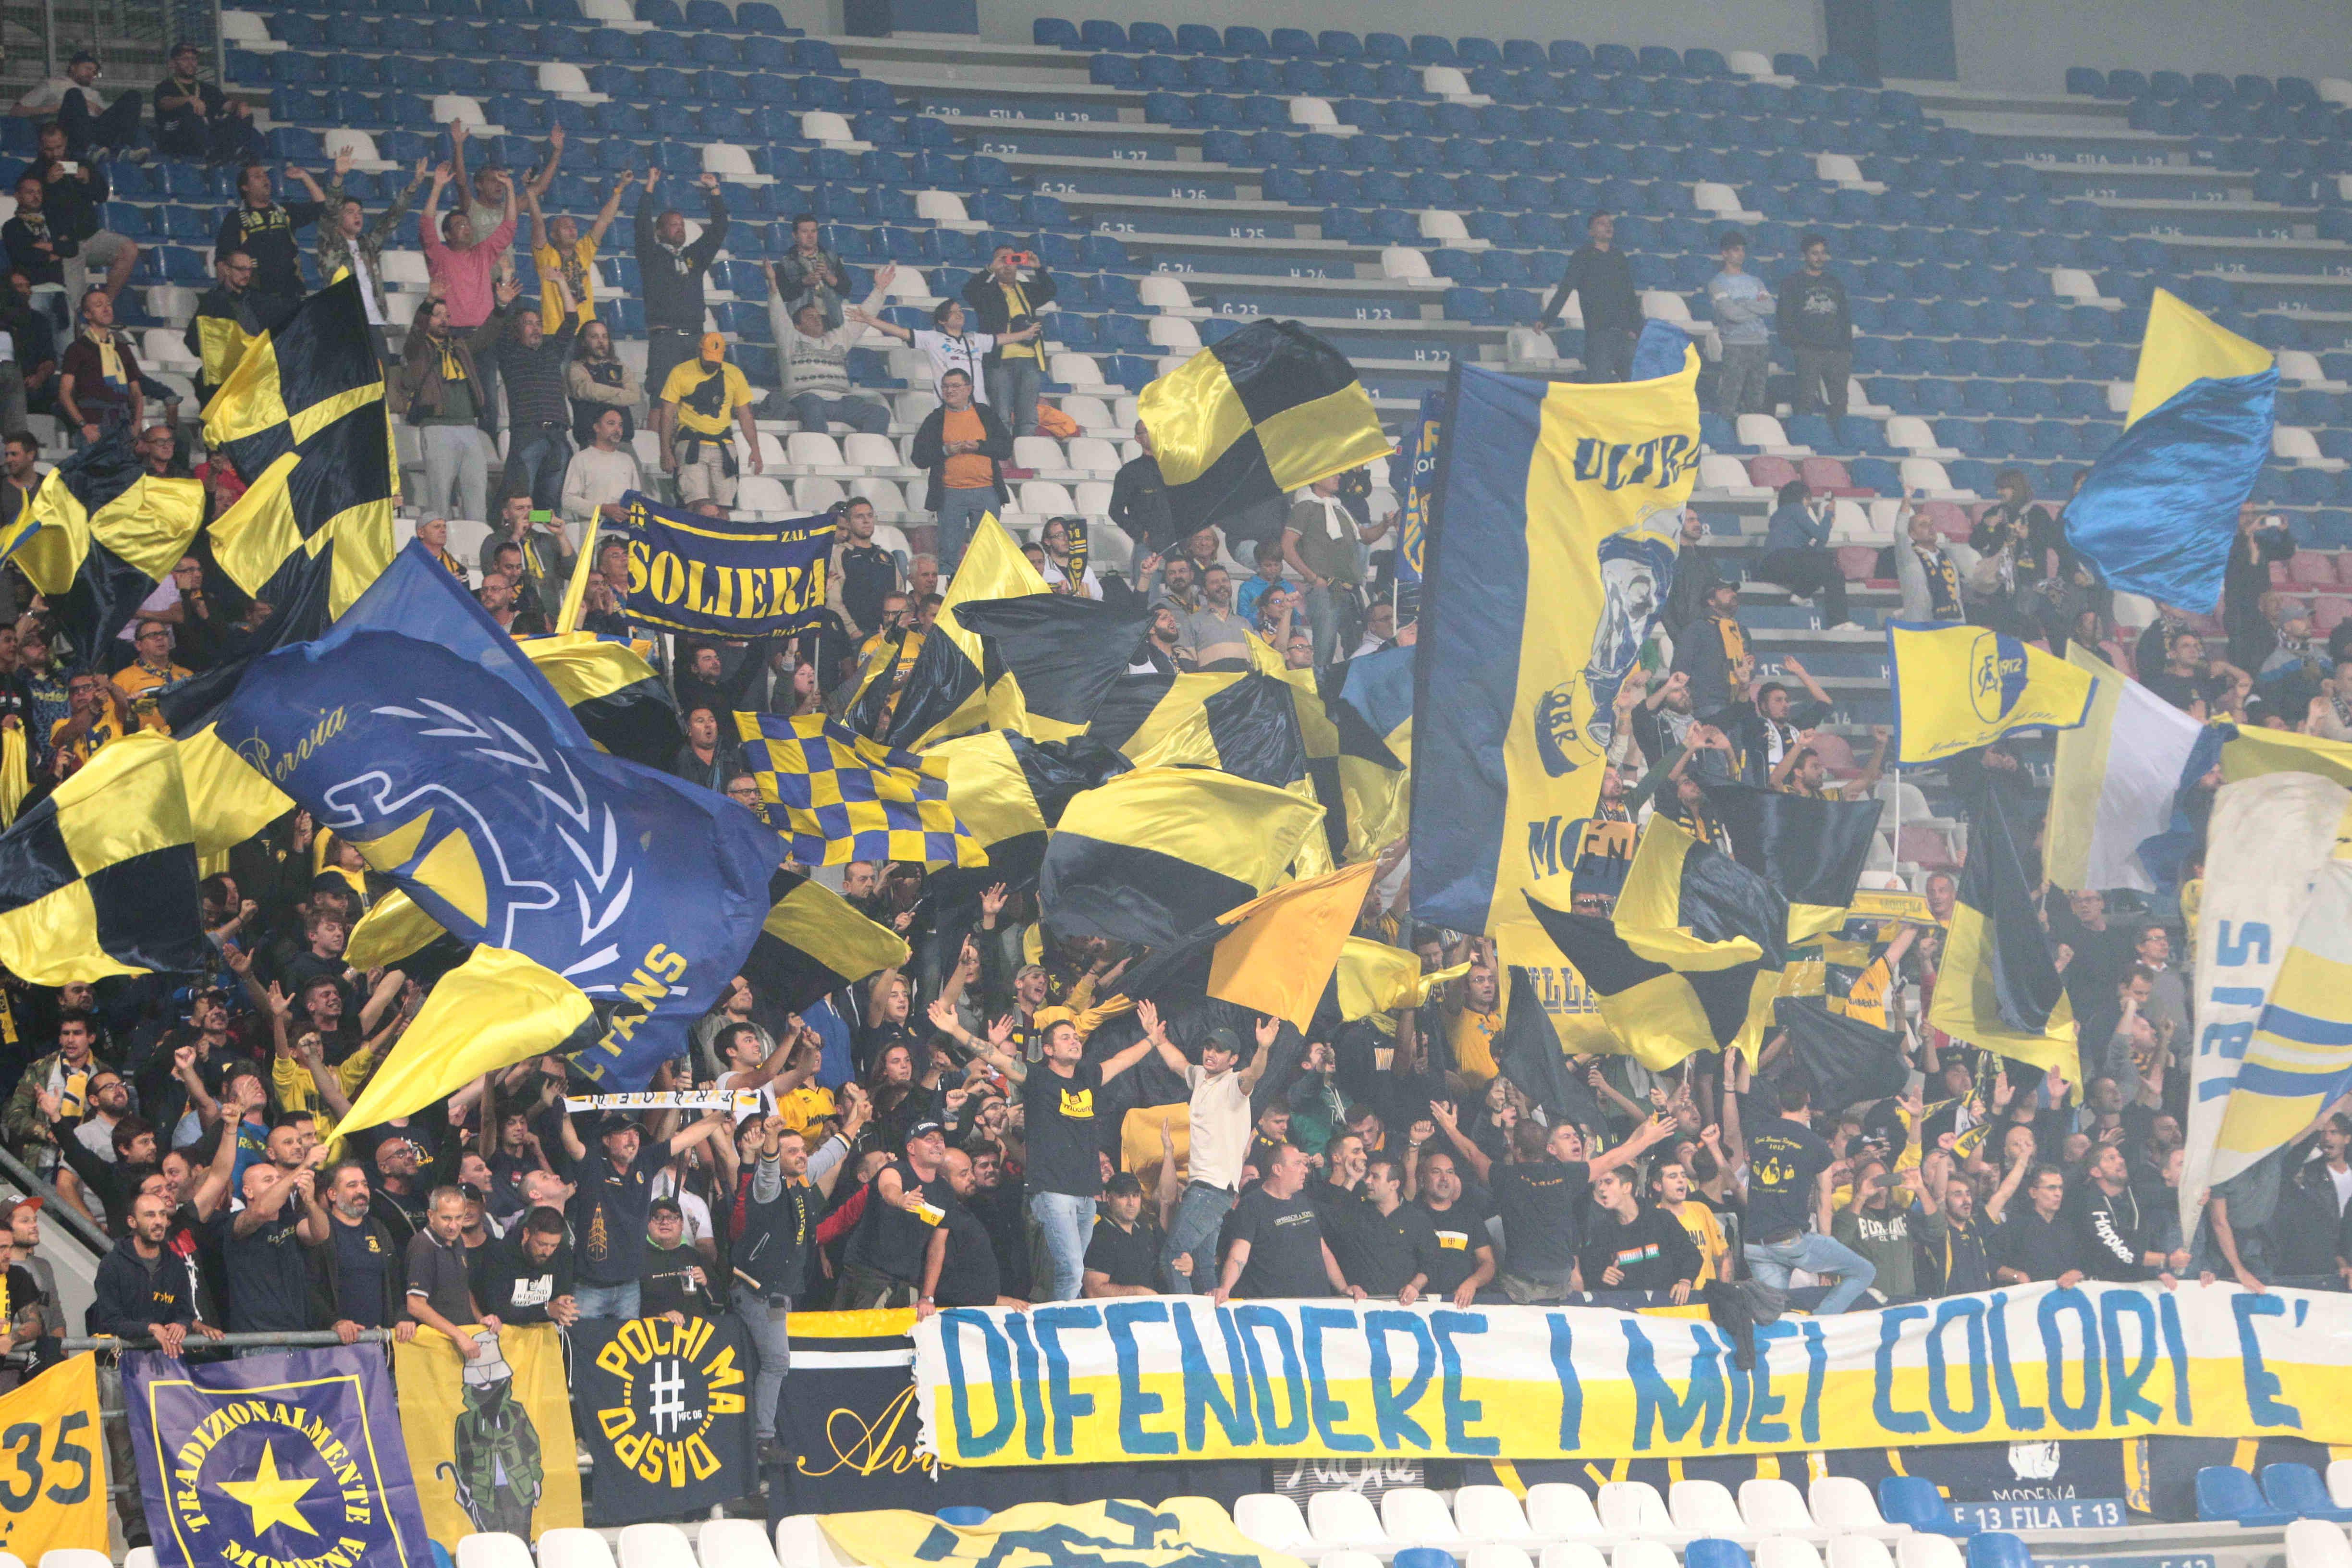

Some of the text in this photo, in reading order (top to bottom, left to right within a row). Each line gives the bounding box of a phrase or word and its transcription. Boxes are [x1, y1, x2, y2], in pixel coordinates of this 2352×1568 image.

[628, 539, 825, 619] SOLIERA
[1998, 658, 2024, 676] 1912
[236, 705, 348, 782] Pervia
[595, 1316, 715, 1382] POCHI
[939, 1288, 2309, 1461] DIFENDERE I MIEI COLORI E'
[175, 1400, 371, 1533] TRADIZIONALMENTE
[1954, 1502, 2119, 1530] F 13 FILA F 13
